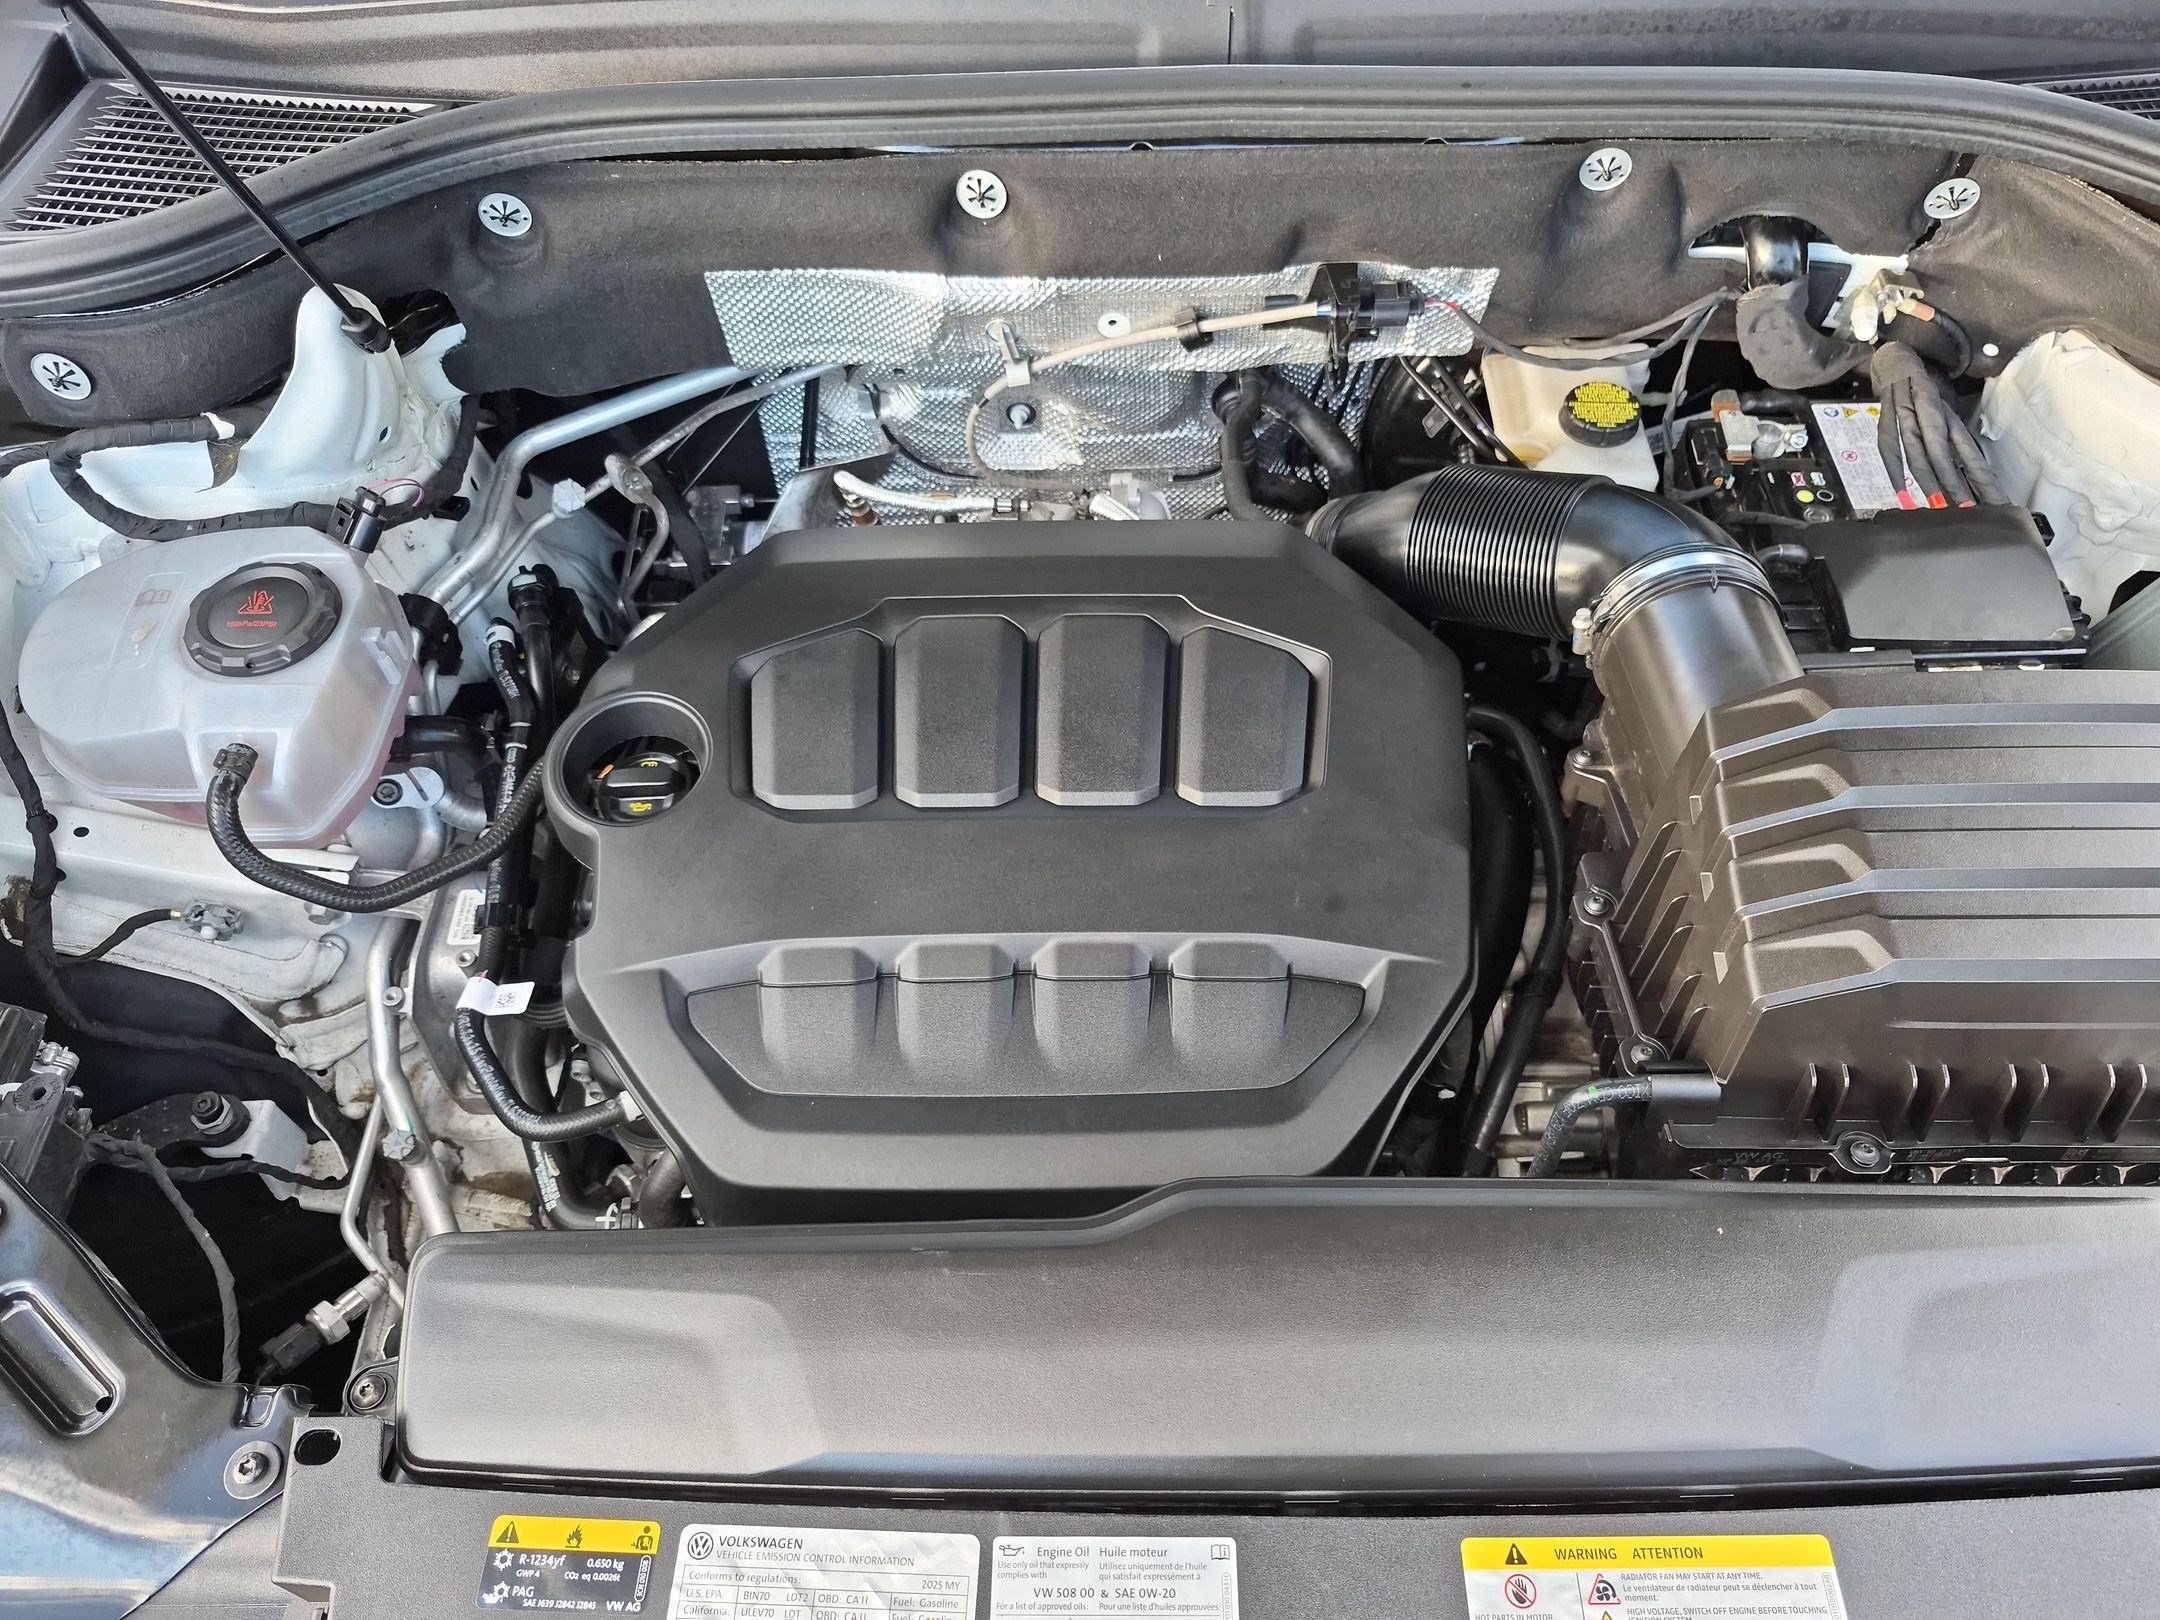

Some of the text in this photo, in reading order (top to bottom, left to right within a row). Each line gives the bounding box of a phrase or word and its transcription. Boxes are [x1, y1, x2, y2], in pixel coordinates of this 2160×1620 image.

[718, 1535, 803, 1549] VOLKSWAGEN
[1037, 1546, 1090, 1560] Engine Oil
[1099, 1547, 1168, 1557] Huile moteur
[1554, 1547, 1704, 1560] WARNING ATTENTION
[519, 1553, 625, 1572] R-1234yf 0.650 kg
[716, 1550, 915, 1566] VEHICLE EMISSION CONTROL INFORMATION
[997, 1561, 1090, 1571] Use only oil that expressly
[1099, 1562, 1126, 1571] Utilisez
[1128, 1563, 1173, 1572] uniquement
[1174, 1562, 1184, 1571] de
[515, 1569, 540, 1578] GWP 4
[688, 1570, 801, 1585] Conforms to regulations:
[997, 1571, 1047, 1580] complies with
[1098, 1572, 1111, 1582] qui
[1112, 1572, 1141, 1581] satisfait
[1143, 1572, 1195, 1582] expressément
[1620, 1573, 1658, 1581] RADIATOR
[1675, 1572, 1691, 1580] MAY
[1693, 1572, 1715, 1580] START
[1716, 1572, 1725, 1580] AT
[1726, 1572, 1742, 1580] ANY
[921, 1579, 960, 1590] 2025 MY
[1622, 1584, 1632, 1592] Le
[1632, 1584, 1675, 1592] ventilateur
[1676, 1584, 1686, 1592] de
[1687, 1583, 1721, 1592] radiateur
[1723, 1583, 1740, 1592] peut
[1752, 1583, 1793, 1591] déclencher
[511, 1586, 535, 1598] PAG
[686, 1589, 703, 1598] U.S.
[743, 1590, 809, 1603] BIN70 LDT2
[1033, 1588, 1176, 1599] VW 508 00 & SAE 0W-20
[522, 1598, 536, 1607] SAE
[818, 1594, 841, 1603] OBD:
[846, 1594, 859, 1605] CA
[893, 1597, 959, 1609] Fuel: Gasoline
[606, 1601, 641, 1612] VW AG
[683, 1605, 731, 1616] California:
[741, 1606, 775, 1618] ULEV70
[996, 1602, 1007, 1610] For
[1016, 1602, 1026, 1610] list
[1028, 1602, 1036, 1610] of
[1037, 1602, 1072, 1612] approved
[1074, 1602, 1089, 1610] oils:
[1099, 1602, 1116, 1611] Pour
[1132, 1602, 1147, 1611] liste
[1627, 1607, 1646, 1615] HIGH
[1683, 1607, 1712, 1615] SWITCH
[1712, 1607, 1727, 1615] OFF
[1729, 1607, 1758, 1615] ENGINE
[1758, 1607, 1788, 1615] BEFORE
[1789, 1606, 1828, 1615] TOUCHING
